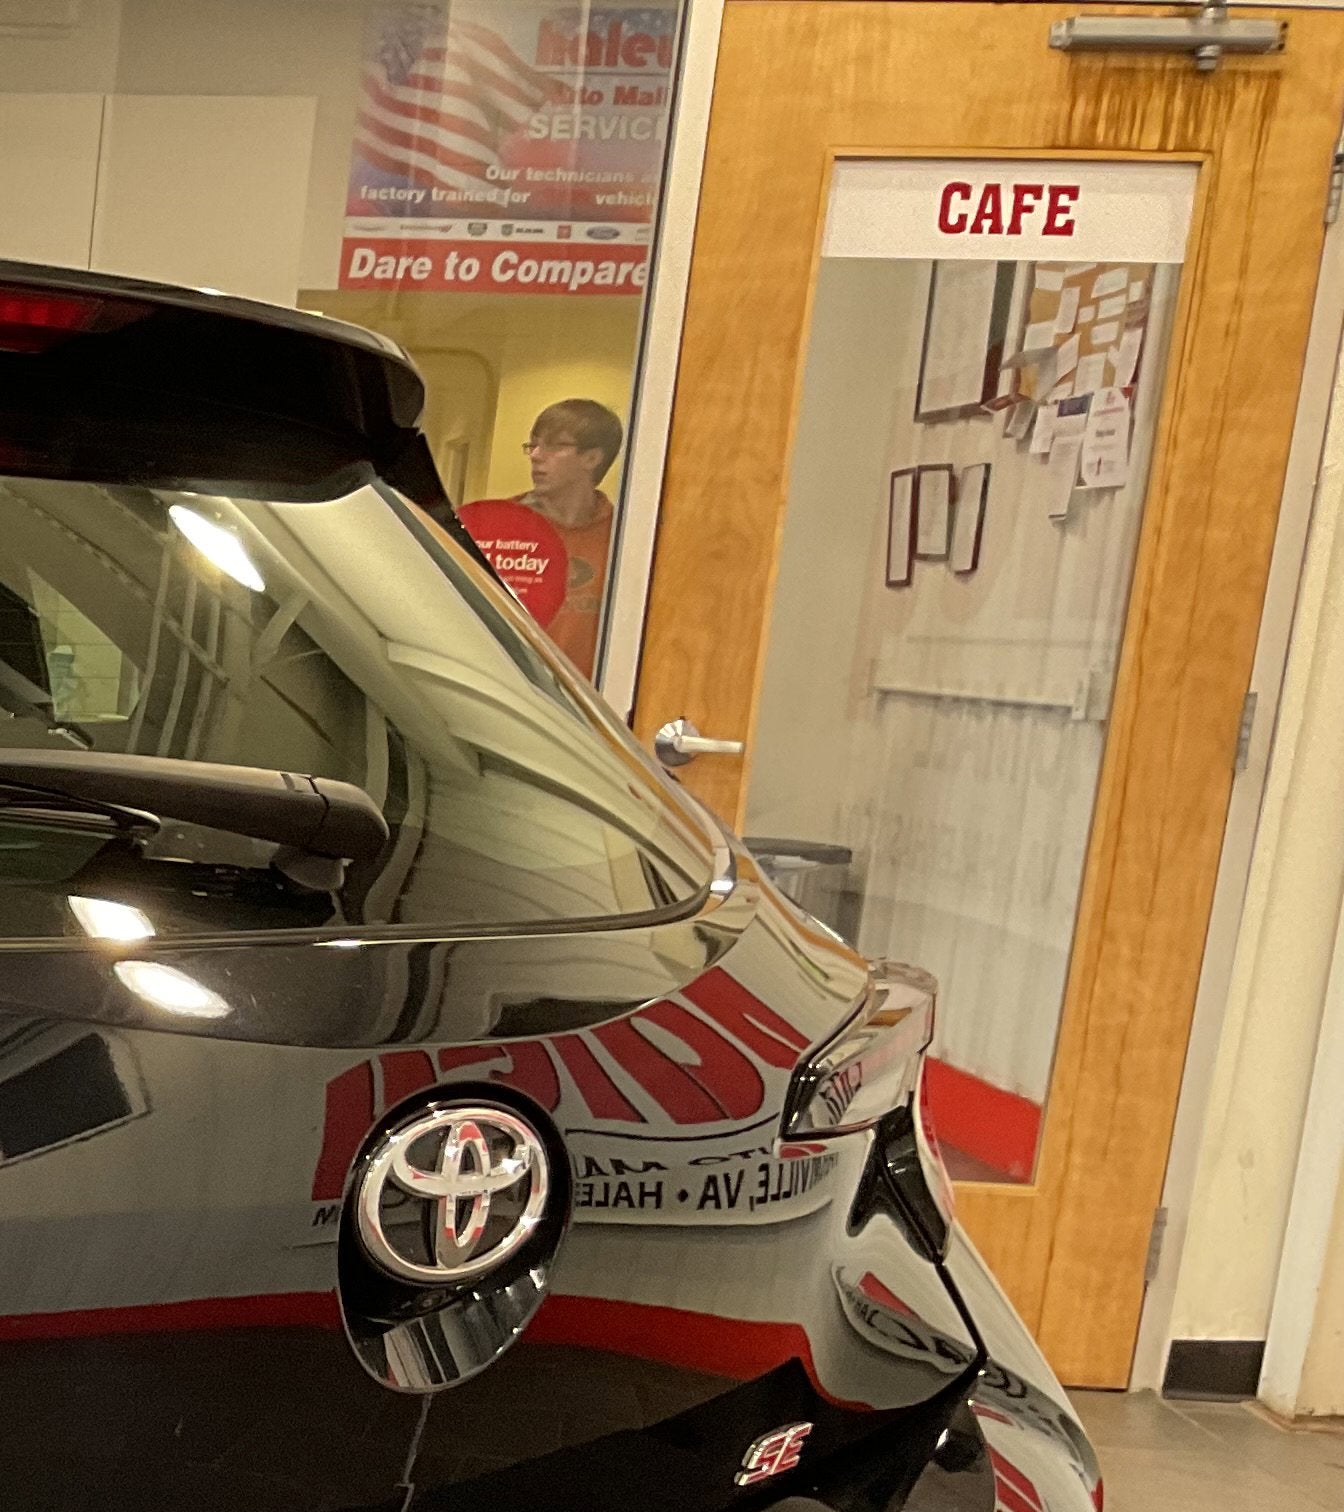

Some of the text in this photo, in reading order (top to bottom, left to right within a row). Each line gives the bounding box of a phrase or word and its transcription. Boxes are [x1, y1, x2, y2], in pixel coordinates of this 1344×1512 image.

[485, 164, 524, 181] Our
[360, 185, 426, 204] factory
[499, 188, 531, 204] for
[594, 190, 657, 206] vehicl
[937, 181, 1080, 236] CAFE
[348, 248, 648, 291] Dare to Compare
[496, 539, 539, 552] battery
[495, 554, 550, 574] today
